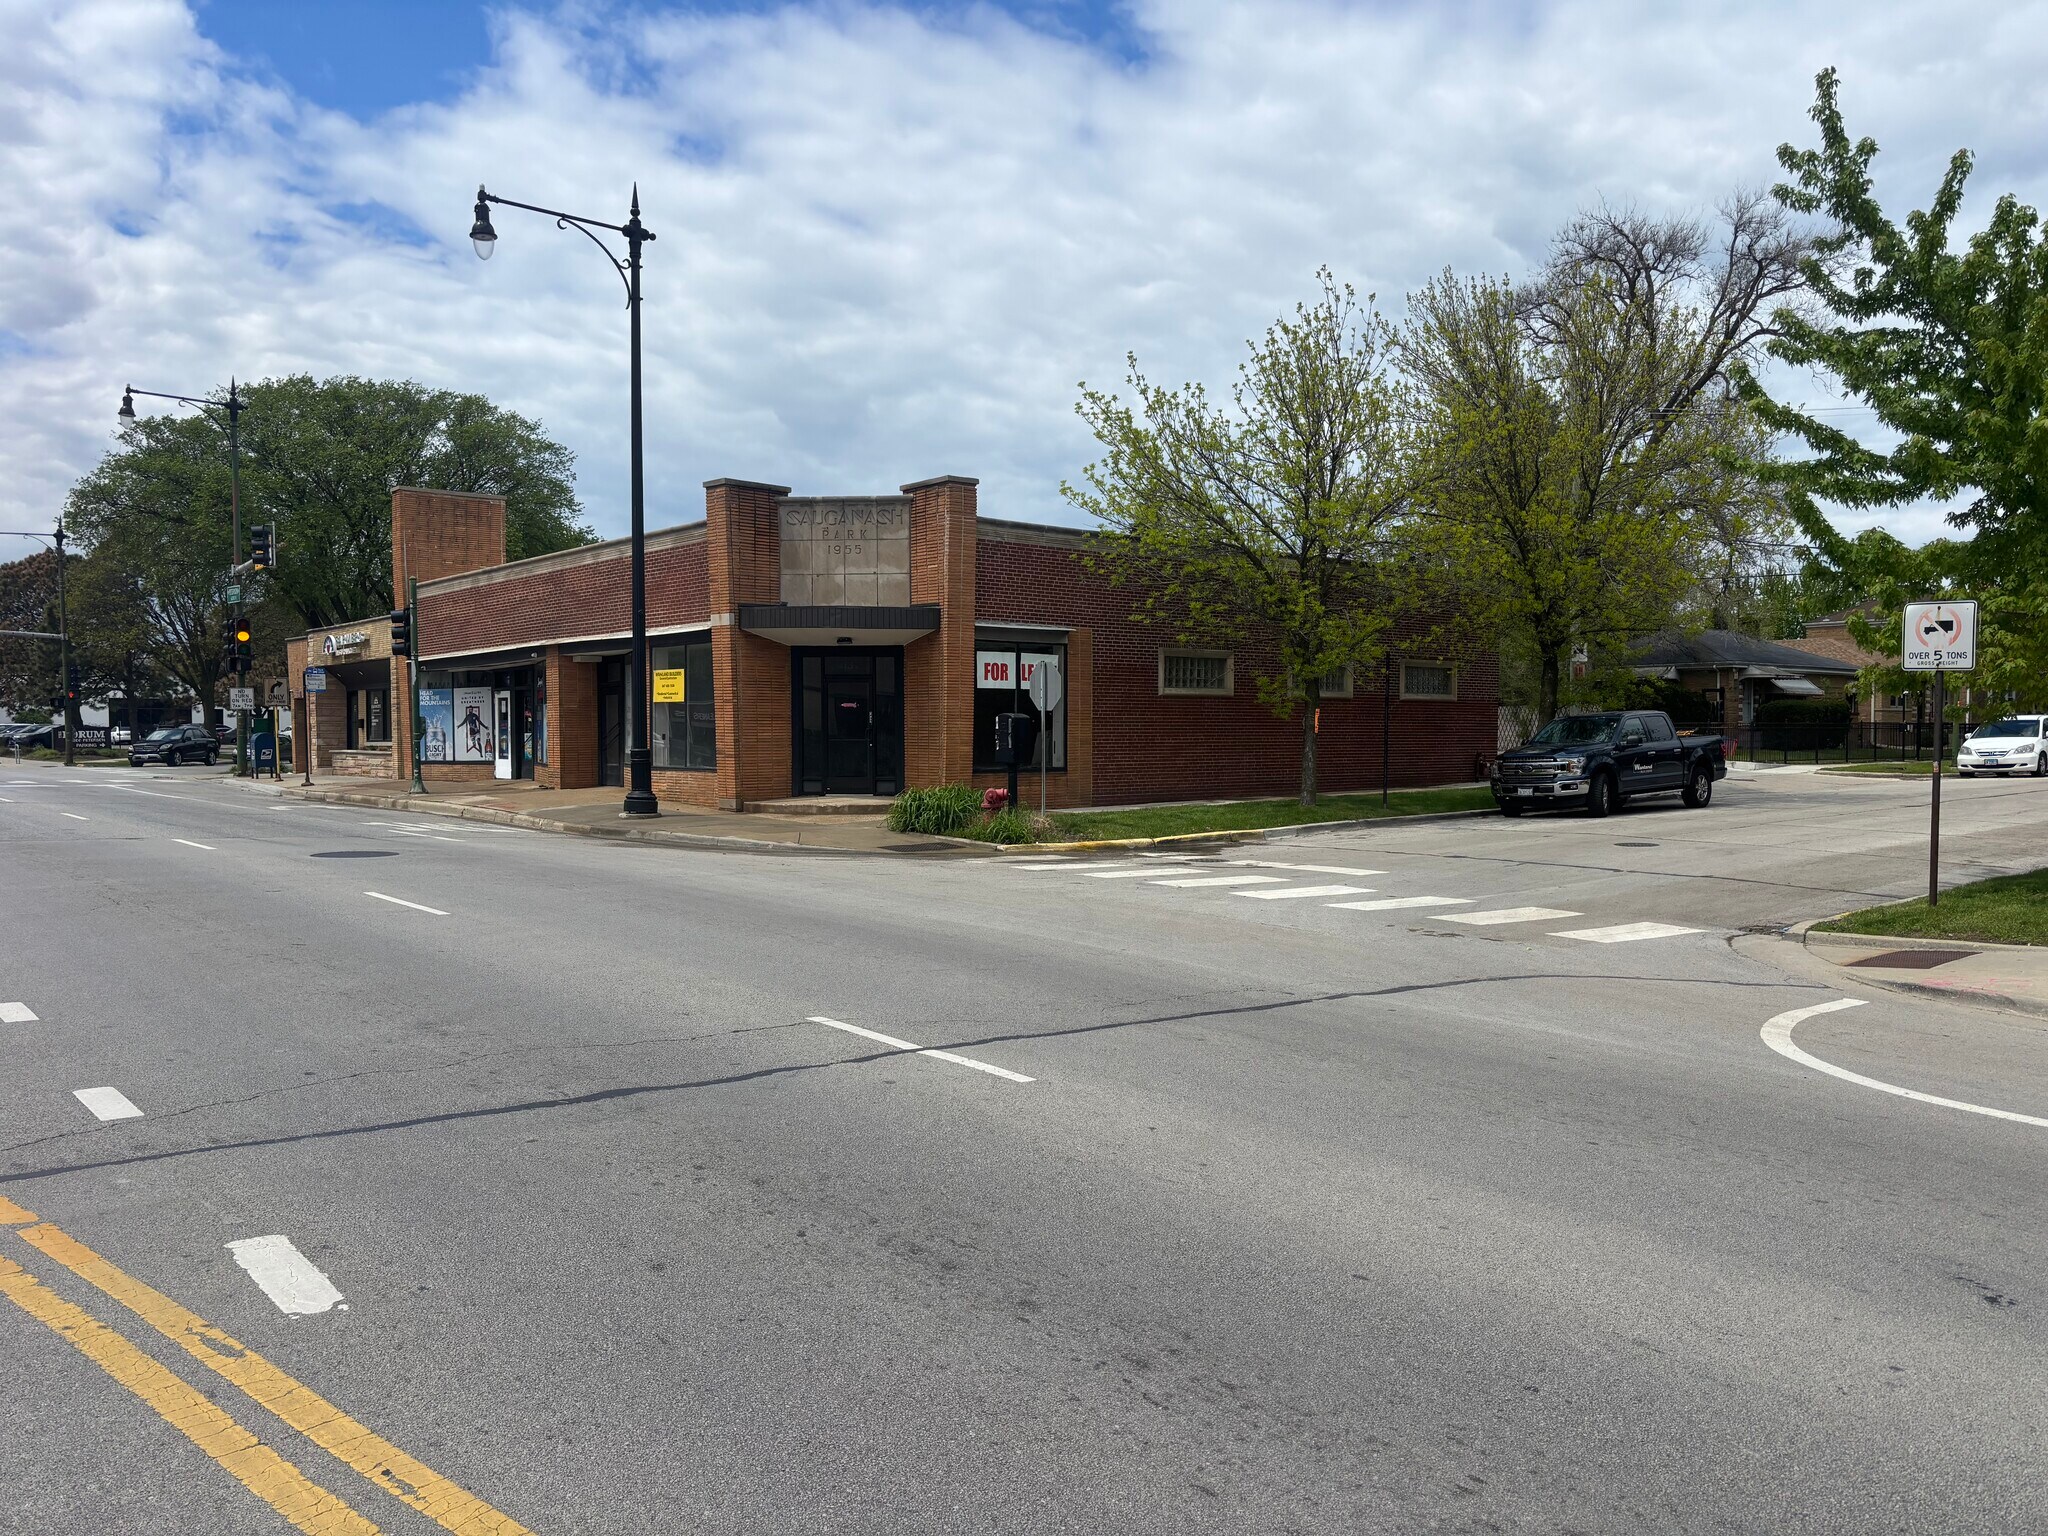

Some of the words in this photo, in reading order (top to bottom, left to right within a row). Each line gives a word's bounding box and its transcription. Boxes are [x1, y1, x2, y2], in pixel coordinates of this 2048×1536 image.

[786, 508, 903, 526] SAUGANASH
[822, 529, 867, 540] PARK
[828, 544, 862, 555] 1955
[1908, 651, 1930, 660] OVER
[1933, 650, 1943, 661] 5
[1946, 651, 1968, 660] TONS
[984, 662, 1009, 681] FOR
[426, 744, 445, 752] BUSCH
